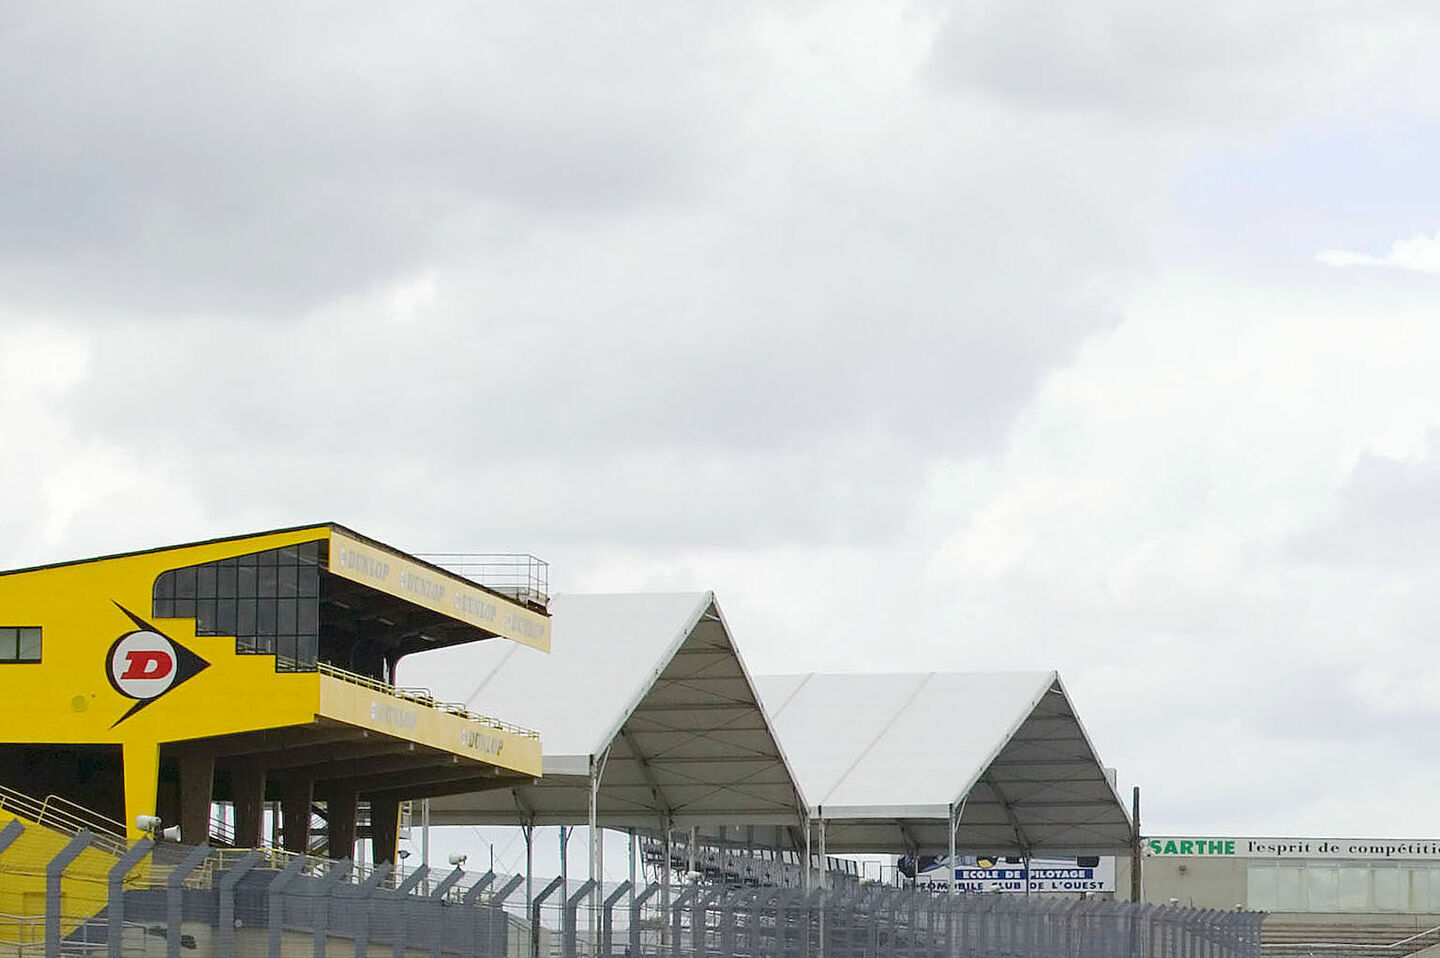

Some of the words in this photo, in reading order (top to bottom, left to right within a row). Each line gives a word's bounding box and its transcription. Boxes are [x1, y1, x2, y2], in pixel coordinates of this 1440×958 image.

[347, 551, 390, 582] DUNLOP
[121, 650, 173, 680] D
[1149, 840, 1236, 855] SARTHE
[1248, 841, 1310, 856] l'esprit
[1318, 842, 1340, 854] de
[963, 869, 999, 879] ECOLE
[1005, 869, 1021, 879] DE
[1052, 881, 1105, 890] L'OUEST
